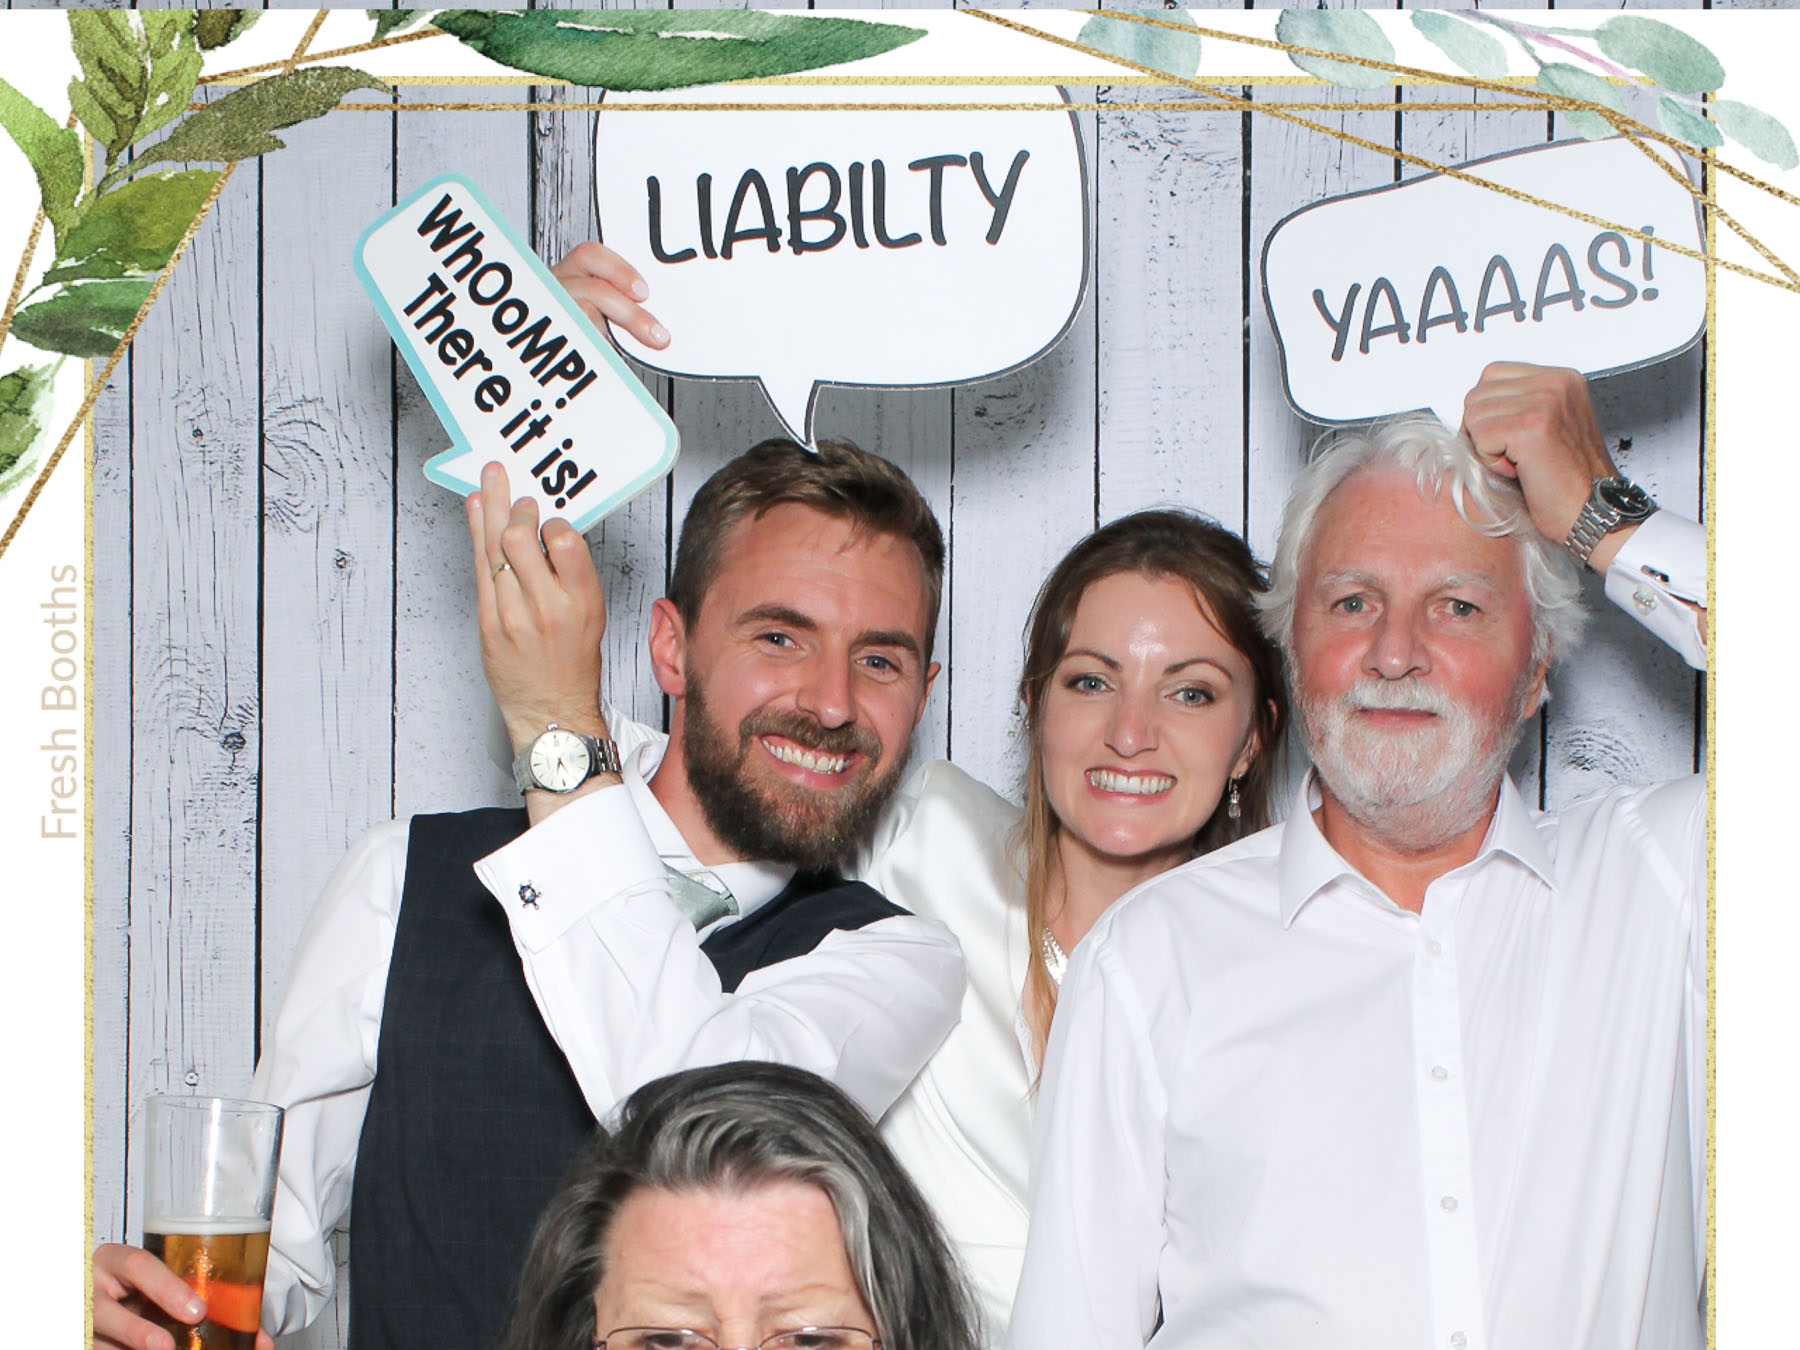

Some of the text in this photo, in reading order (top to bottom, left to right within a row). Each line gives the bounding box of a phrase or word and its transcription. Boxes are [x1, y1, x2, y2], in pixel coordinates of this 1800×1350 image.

[646, 150, 1030, 264] LIABILTY
[1312, 225, 1660, 363] YAAAAS!
[403, 272, 598, 510] There it is!
